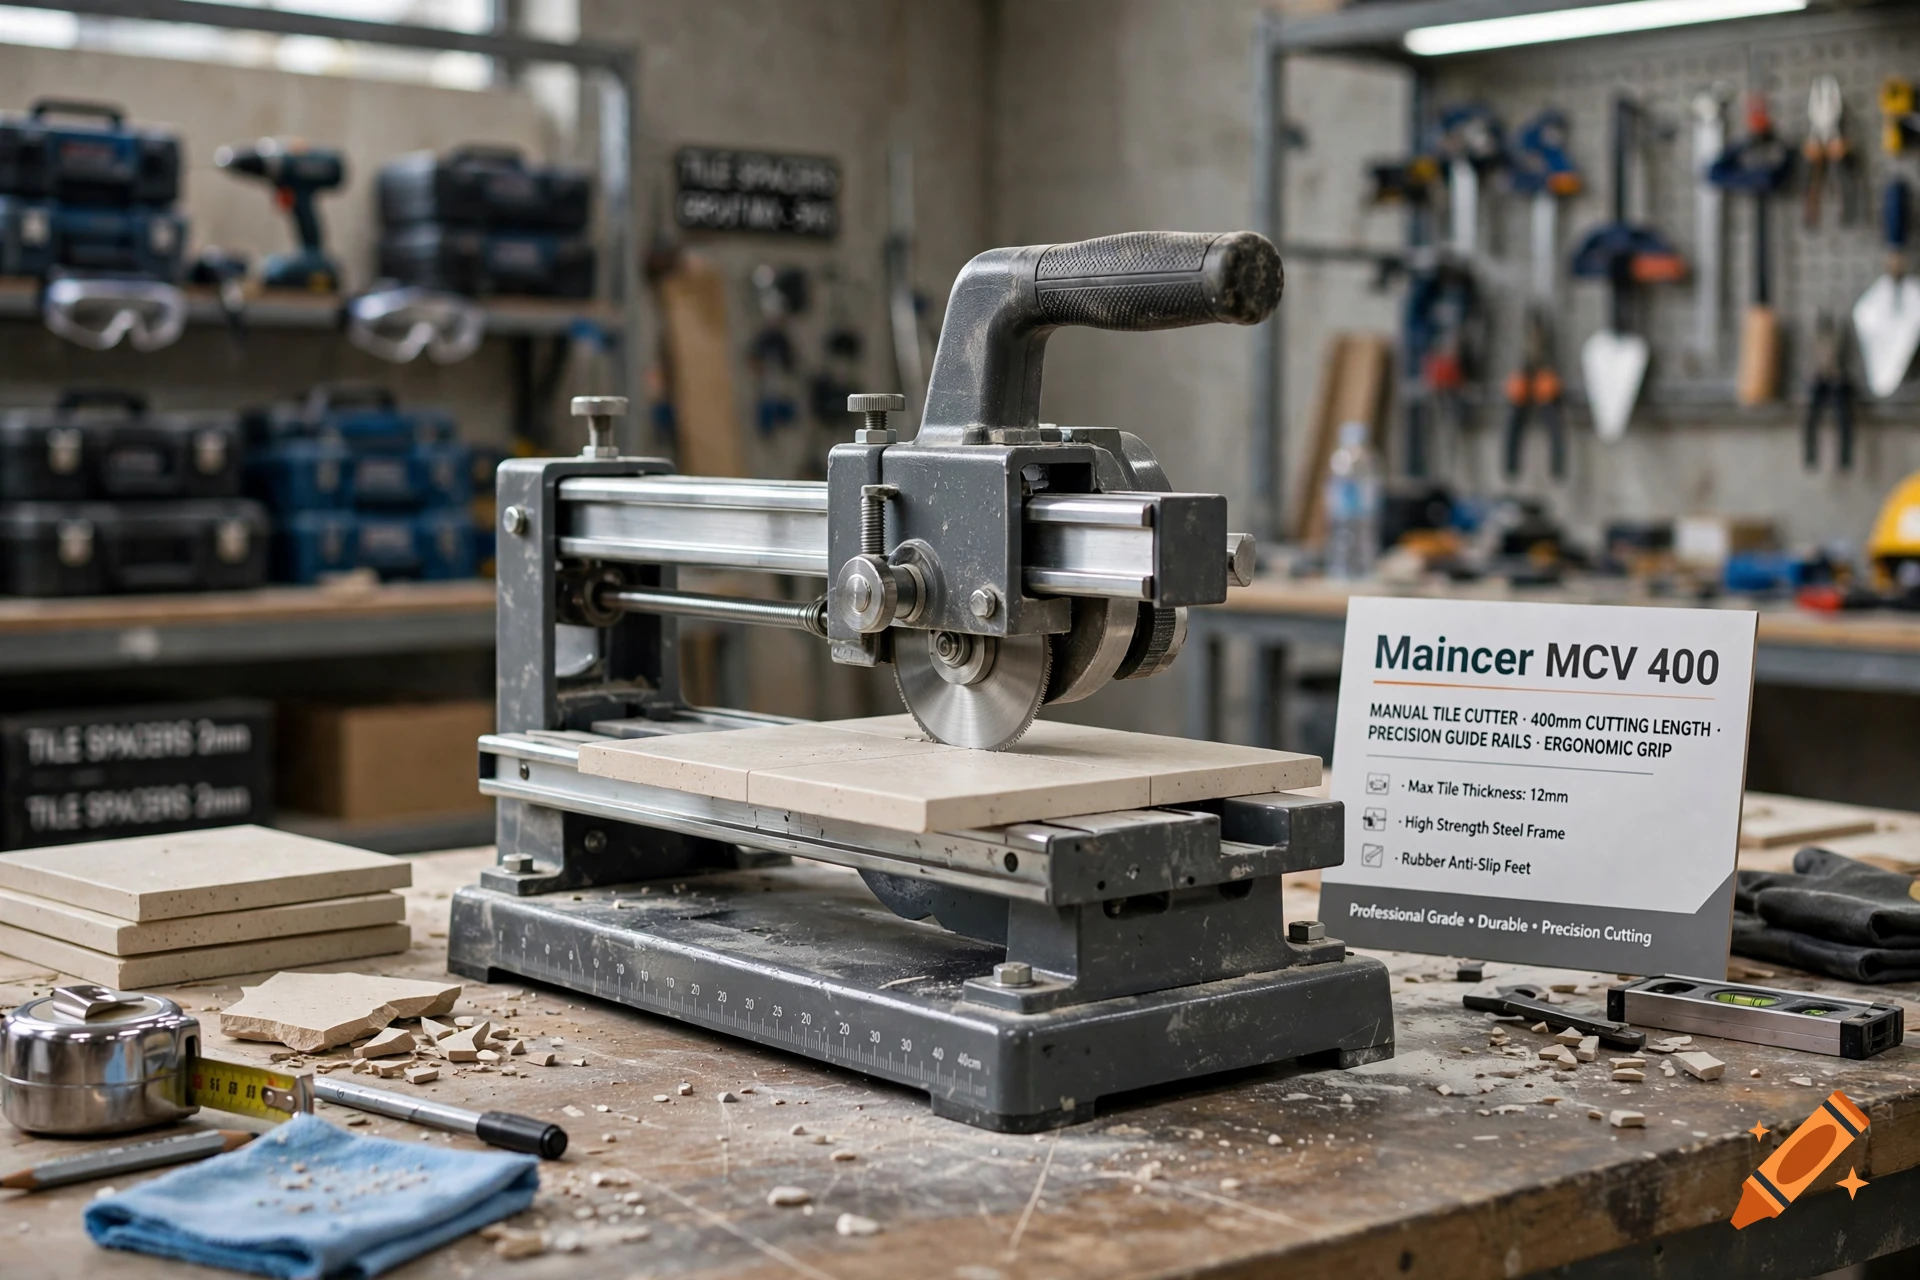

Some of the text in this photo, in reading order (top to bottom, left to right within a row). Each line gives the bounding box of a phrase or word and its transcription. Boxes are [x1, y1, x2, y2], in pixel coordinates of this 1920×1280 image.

[1375, 634, 1720, 686] Maincer MCV 400
[1369, 702, 1712, 737] MANUAL TILE CUTTER 400mm CUTTING LENGTH
[1367, 724, 1673, 759] PRECISION GUIDE RAILS ERGONOMIC GRIP
[1408, 779, 1569, 804] Max Tile Thickness: 12mm
[1405, 815, 1566, 841] High Strength Steel Frame
[1401, 851, 1532, 876] Rubber Anti-Slip Feet
[1349, 902, 1652, 948] Professional Grade Durable Precision Cutting
[666, 976, 675, 989] 10
[691, 983, 700, 996] 20
[717, 990, 727, 1003] 20
[745, 997, 755, 1010] 30
[772, 1005, 783, 1018] 25
[801, 1012, 811, 1025] 20
[839, 1022, 850, 1036] 20
[869, 1030, 881, 1044] 30
[901, 1038, 912, 1052] 30
[931, 1046, 944, 1061] 40
[957, 1051, 982, 1071] 40cm
